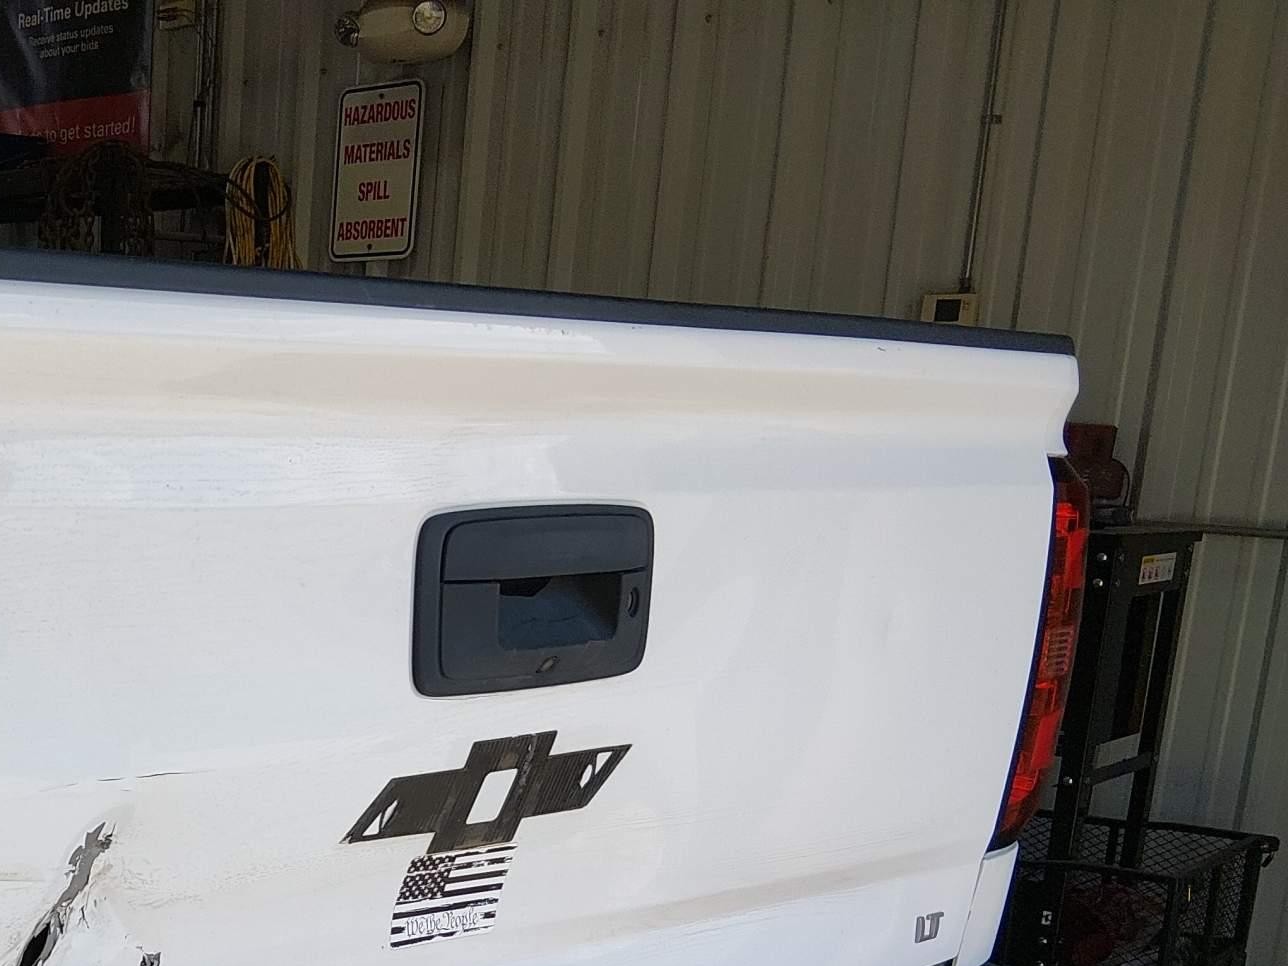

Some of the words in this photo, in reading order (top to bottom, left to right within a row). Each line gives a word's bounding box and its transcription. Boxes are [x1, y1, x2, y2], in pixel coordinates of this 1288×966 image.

[18, 6, 71, 29] Real-Time
[74, 0, 129, 19] Updates
[80, 24, 114, 40] updates
[344, 98, 416, 126] HAZARDOUS
[59, 123, 81, 145] get
[83, 114, 136, 139] started!
[344, 139, 411, 165] MATERIALS
[358, 180, 390, 202] SPILL
[337, 218, 408, 242] ABSORBENT
[915, 911, 944, 943] LT
